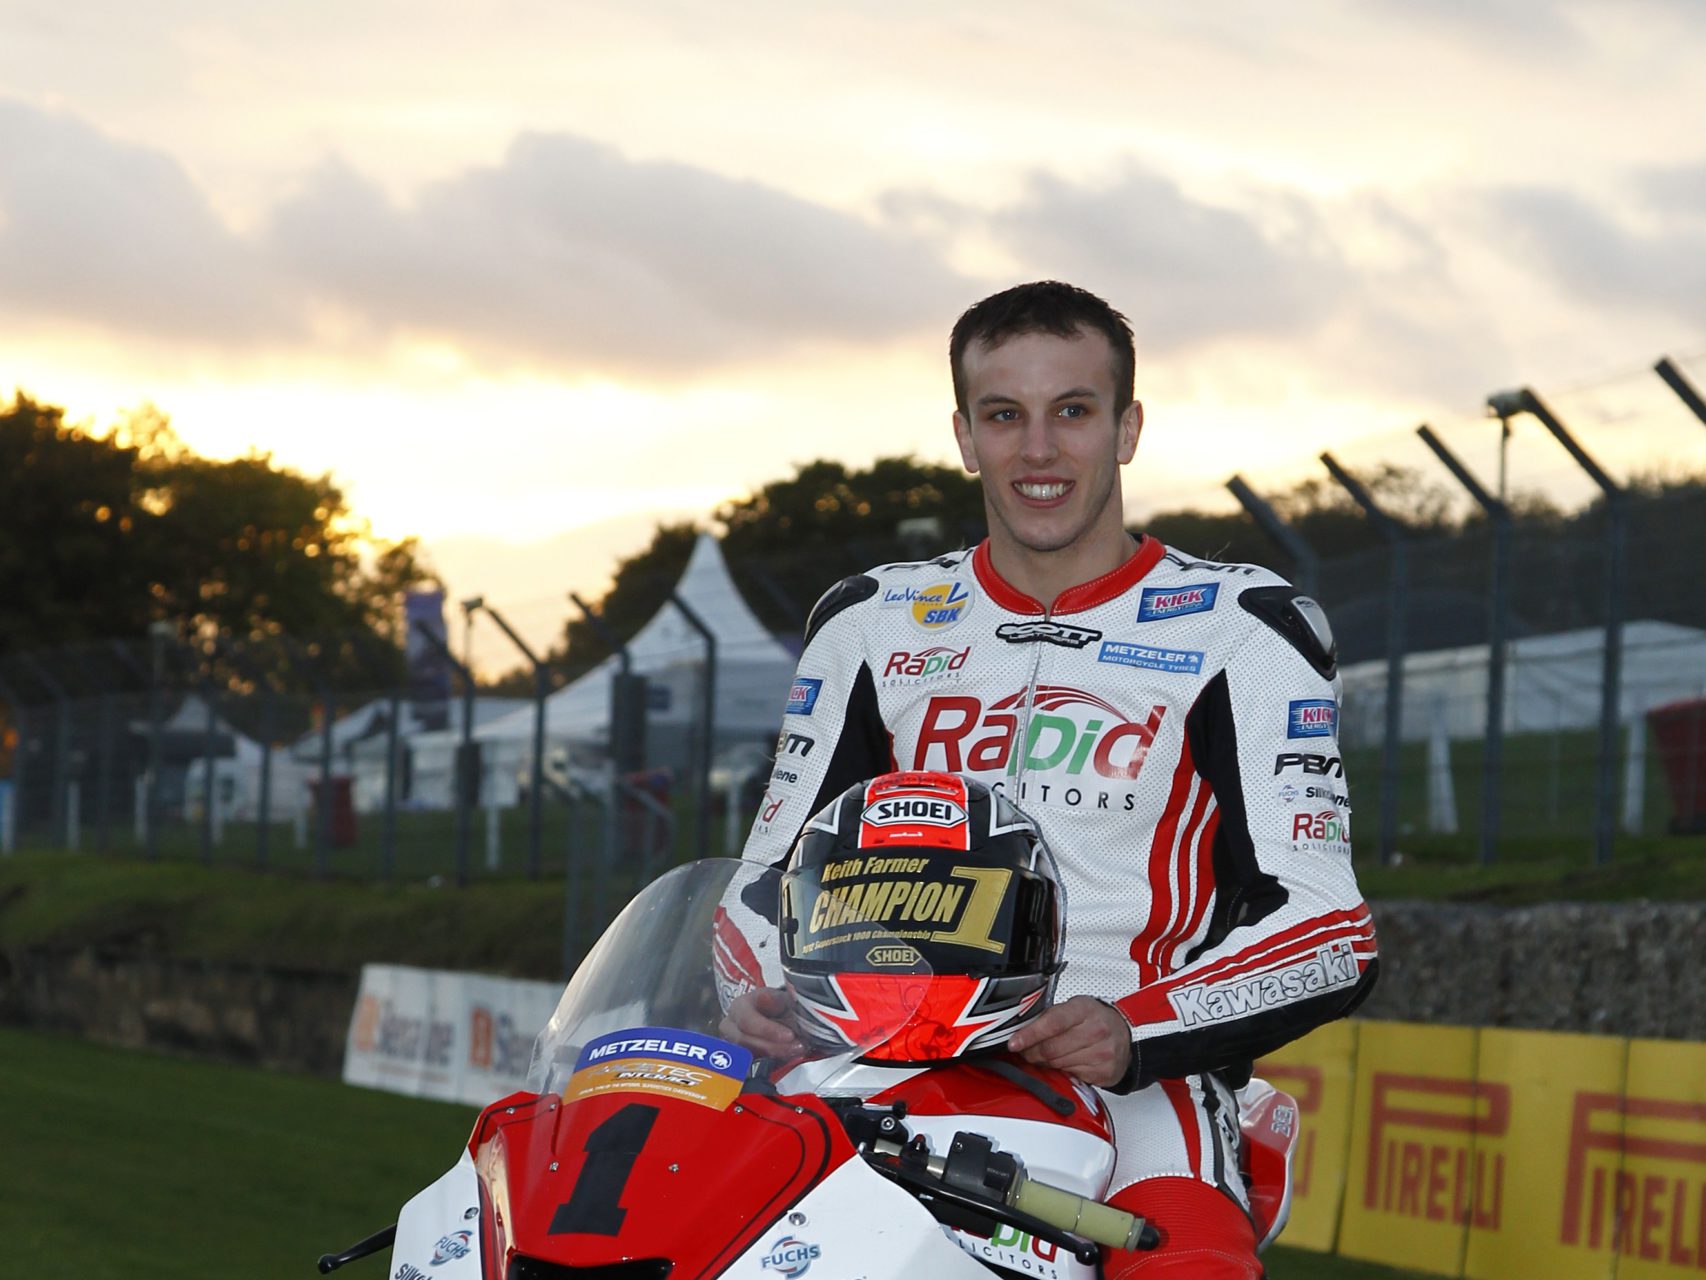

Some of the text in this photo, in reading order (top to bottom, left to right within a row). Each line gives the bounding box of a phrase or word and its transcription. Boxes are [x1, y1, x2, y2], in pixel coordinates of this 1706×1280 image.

[1153, 589, 1204, 609] KICK
[924, 607, 962, 624] SBK
[883, 646, 971, 677] Rapid
[1102, 655, 1196, 672] MOTORCYCLE TYRES
[1105, 644, 1186, 662] METZELER
[913, 689, 1167, 780] Rapid
[877, 801, 952, 820] SHOEI
[992, 783, 1135, 811] CITORS
[821, 856, 930, 883] Keith Farmer
[809, 866, 1013, 954] CHAMPION 1
[873, 950, 916, 963] SHOEI
[1172, 943, 1359, 1027] Kawasaki
[588, 1039, 708, 1061] METZELER
[1364, 1071, 1511, 1231] PIRELLI
[547, 1103, 661, 1237] 1
[1560, 1090, 1706, 1272] PIREL
[436, 1236, 471, 1260] FUCHS
[761, 1244, 821, 1270] FUCHS
[958, 1239, 1058, 1280] LICITORS
